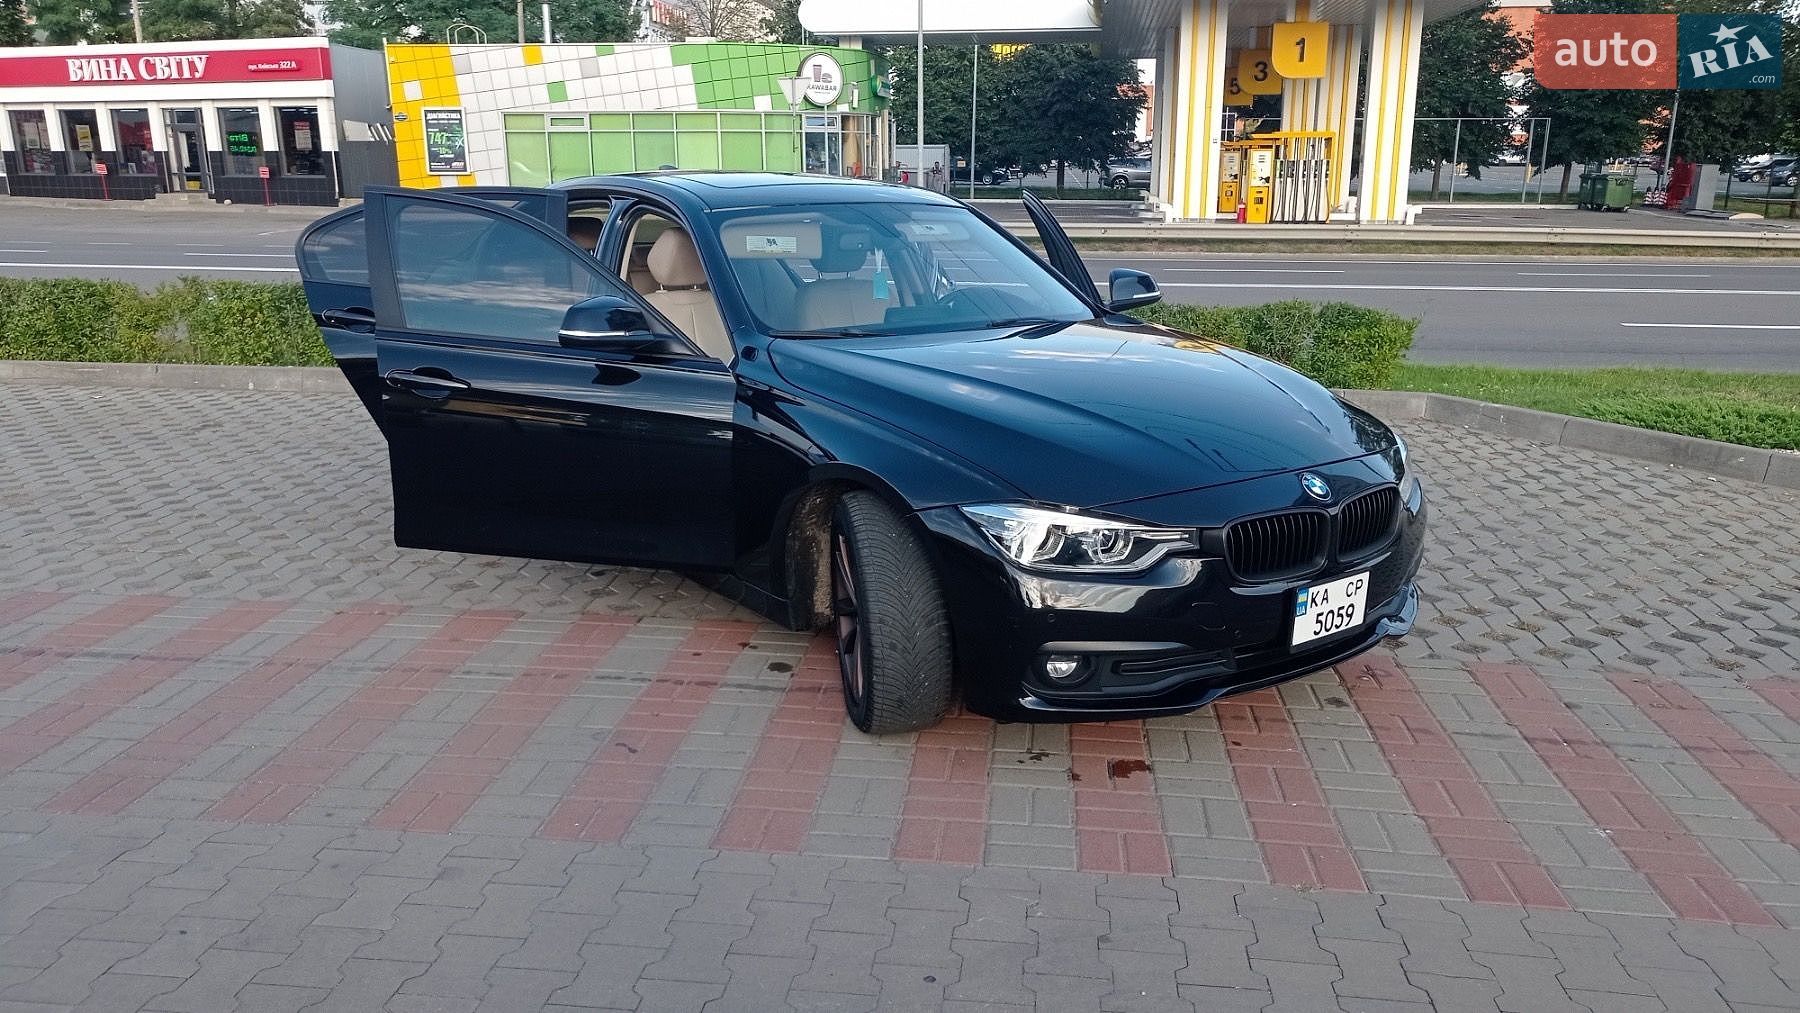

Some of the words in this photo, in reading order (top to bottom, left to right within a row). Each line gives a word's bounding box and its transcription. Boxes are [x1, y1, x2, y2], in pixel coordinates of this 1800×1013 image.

[1295, 37, 1306, 62] 1
[66, 58, 136, 81] ВИНА
[138, 54, 209, 80] СВІТУ
[1253, 61, 1268, 82] 3
[1230, 77, 1240, 95] 5
[1310, 588, 1329, 608] KA
[1345, 579, 1364, 597] CP
[1296, 605, 1306, 615] UA
[1313, 603, 1355, 636] 5059
